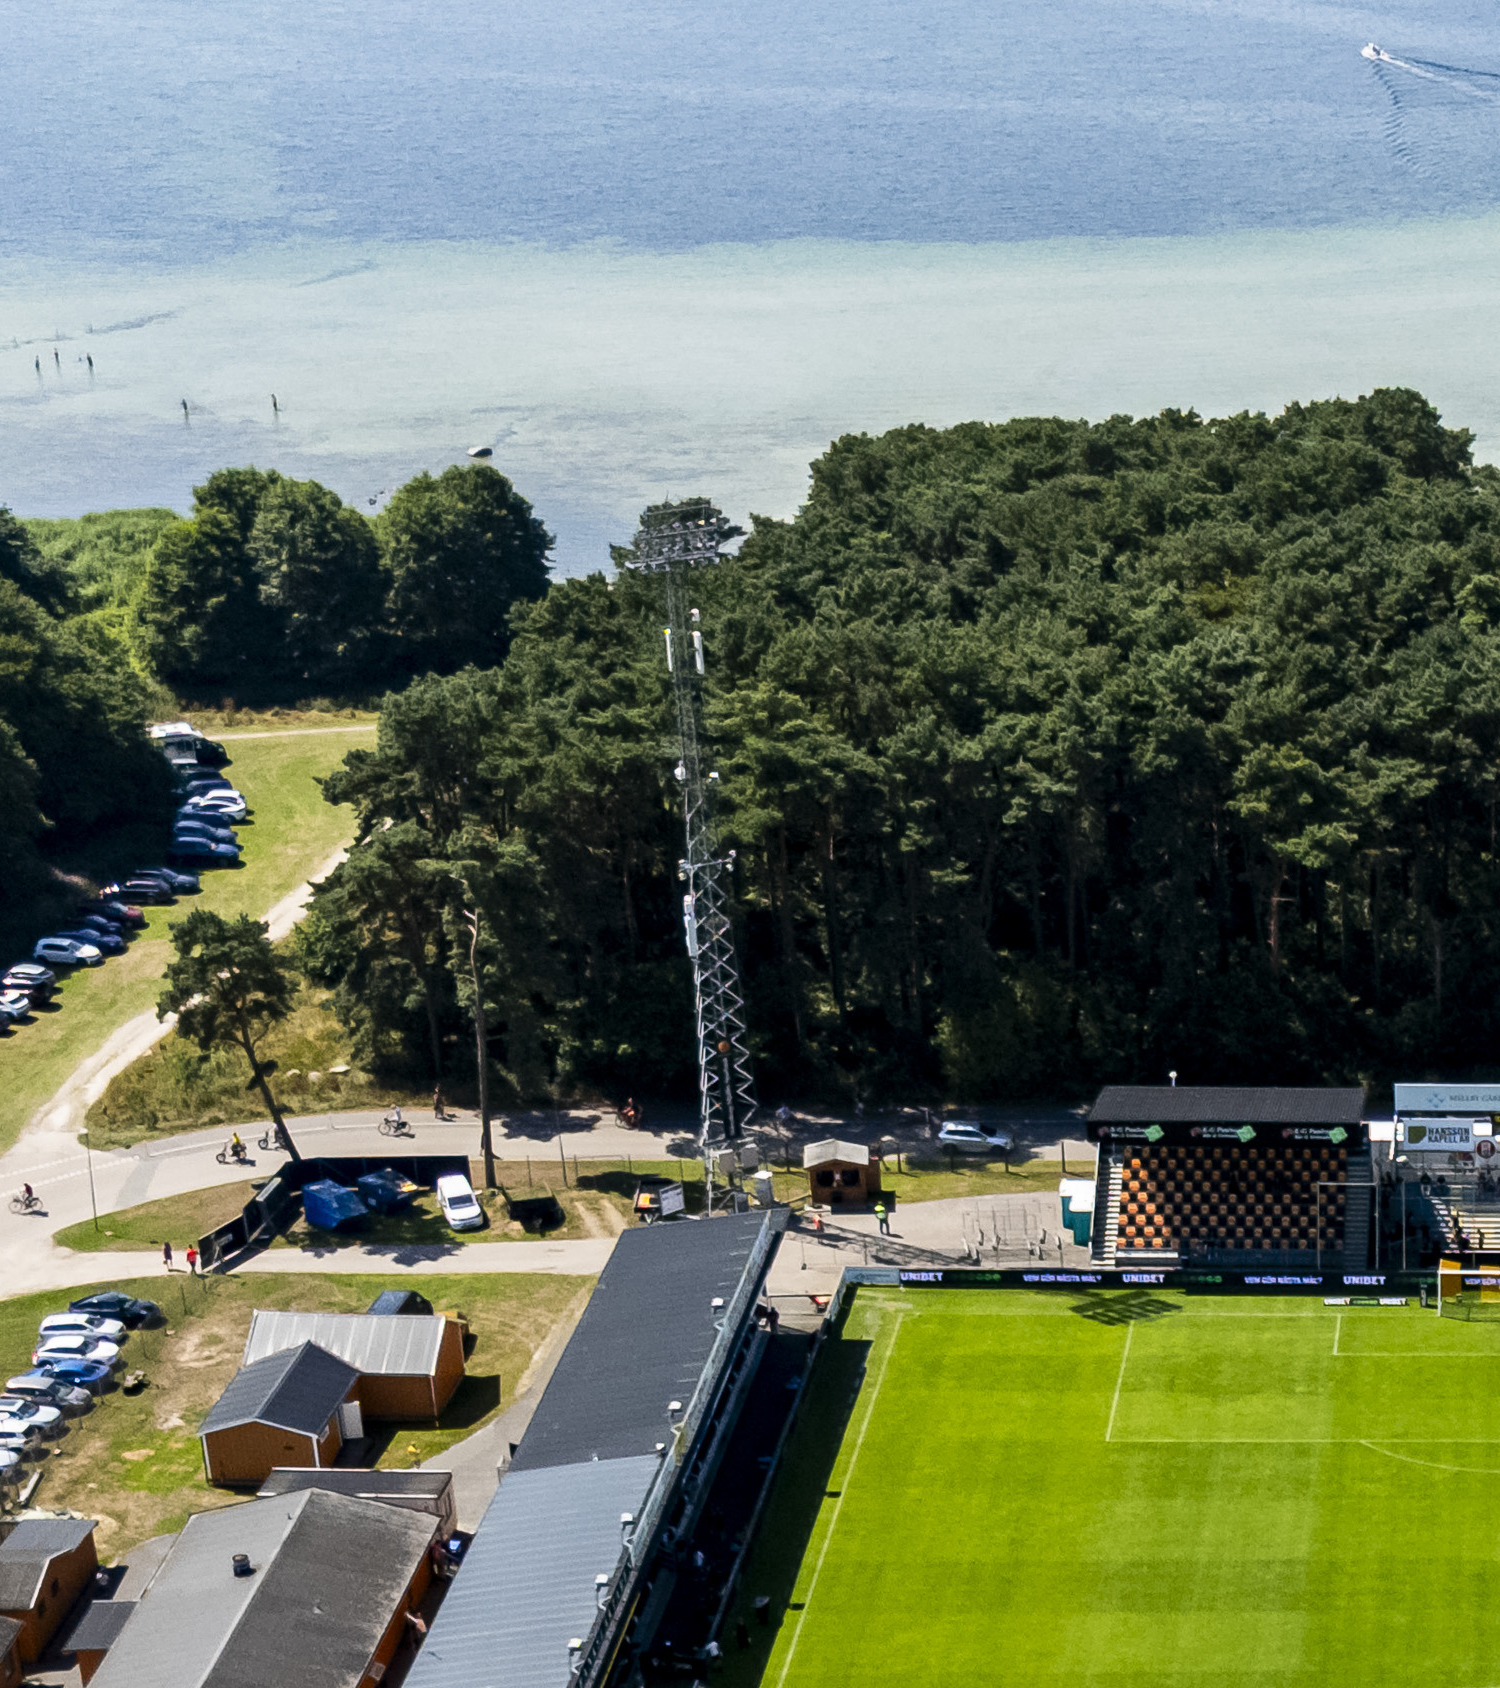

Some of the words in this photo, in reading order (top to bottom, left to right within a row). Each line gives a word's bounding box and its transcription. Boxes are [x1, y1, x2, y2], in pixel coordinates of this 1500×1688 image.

[1428, 1127, 1470, 1136] HANSSON
[900, 1272, 943, 1281] UNIBET
[1122, 1274, 1165, 1283] UNIBET
[1343, 1276, 1386, 1285] UNIBET
